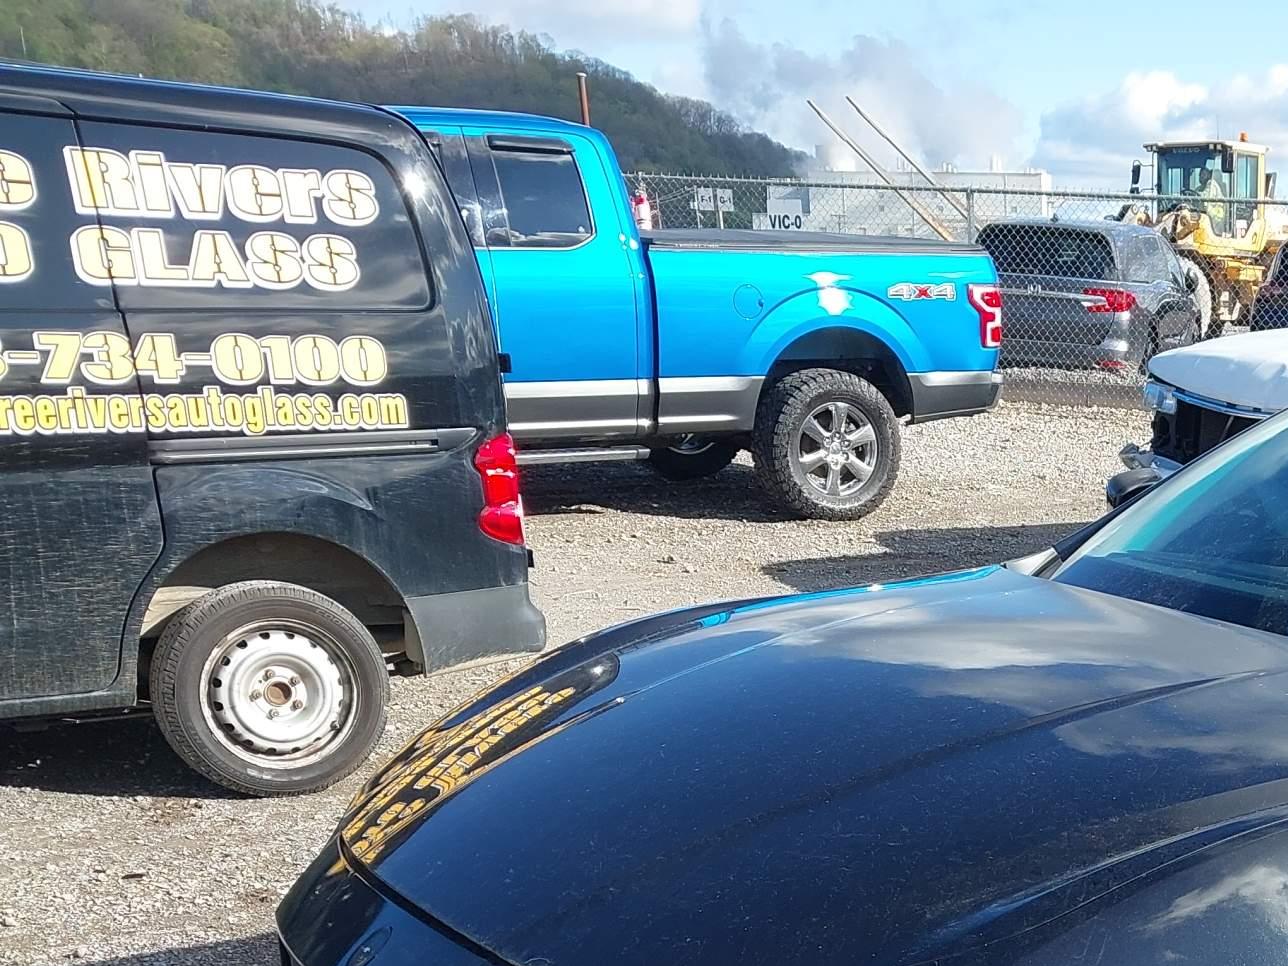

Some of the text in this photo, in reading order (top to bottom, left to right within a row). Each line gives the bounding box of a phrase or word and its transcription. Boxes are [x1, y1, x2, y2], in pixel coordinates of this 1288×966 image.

[63, 146, 379, 226] Rivers
[71, 225, 360, 291] GLASS
[0, 331, 388, 386] -734-0100
